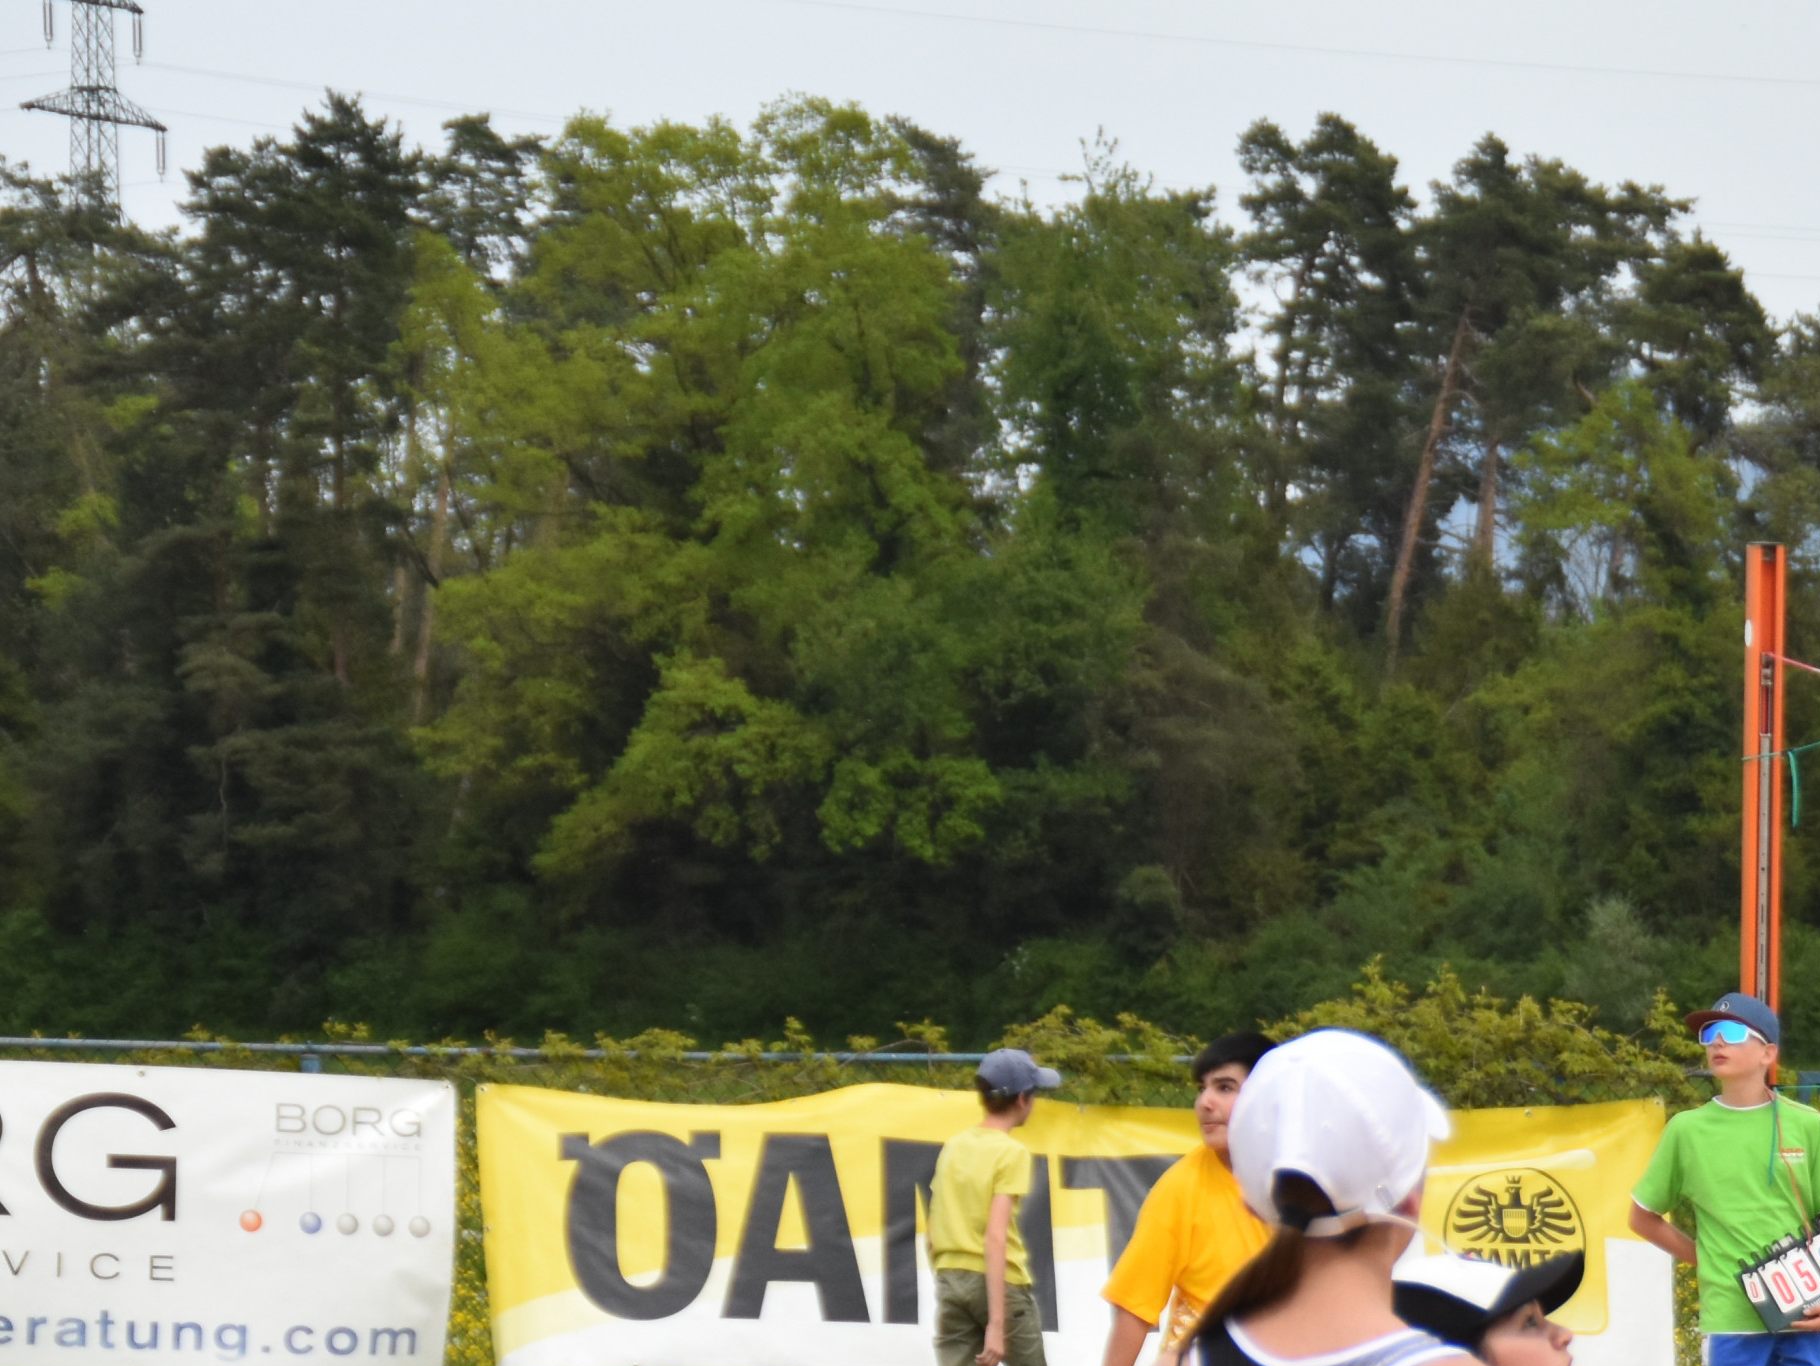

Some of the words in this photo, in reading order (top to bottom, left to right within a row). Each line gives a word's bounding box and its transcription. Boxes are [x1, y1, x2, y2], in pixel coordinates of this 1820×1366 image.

[275, 1103, 422, 1138] BORG
[0, 1091, 177, 1221] G
[4, 1250, 175, 1281] VICE
